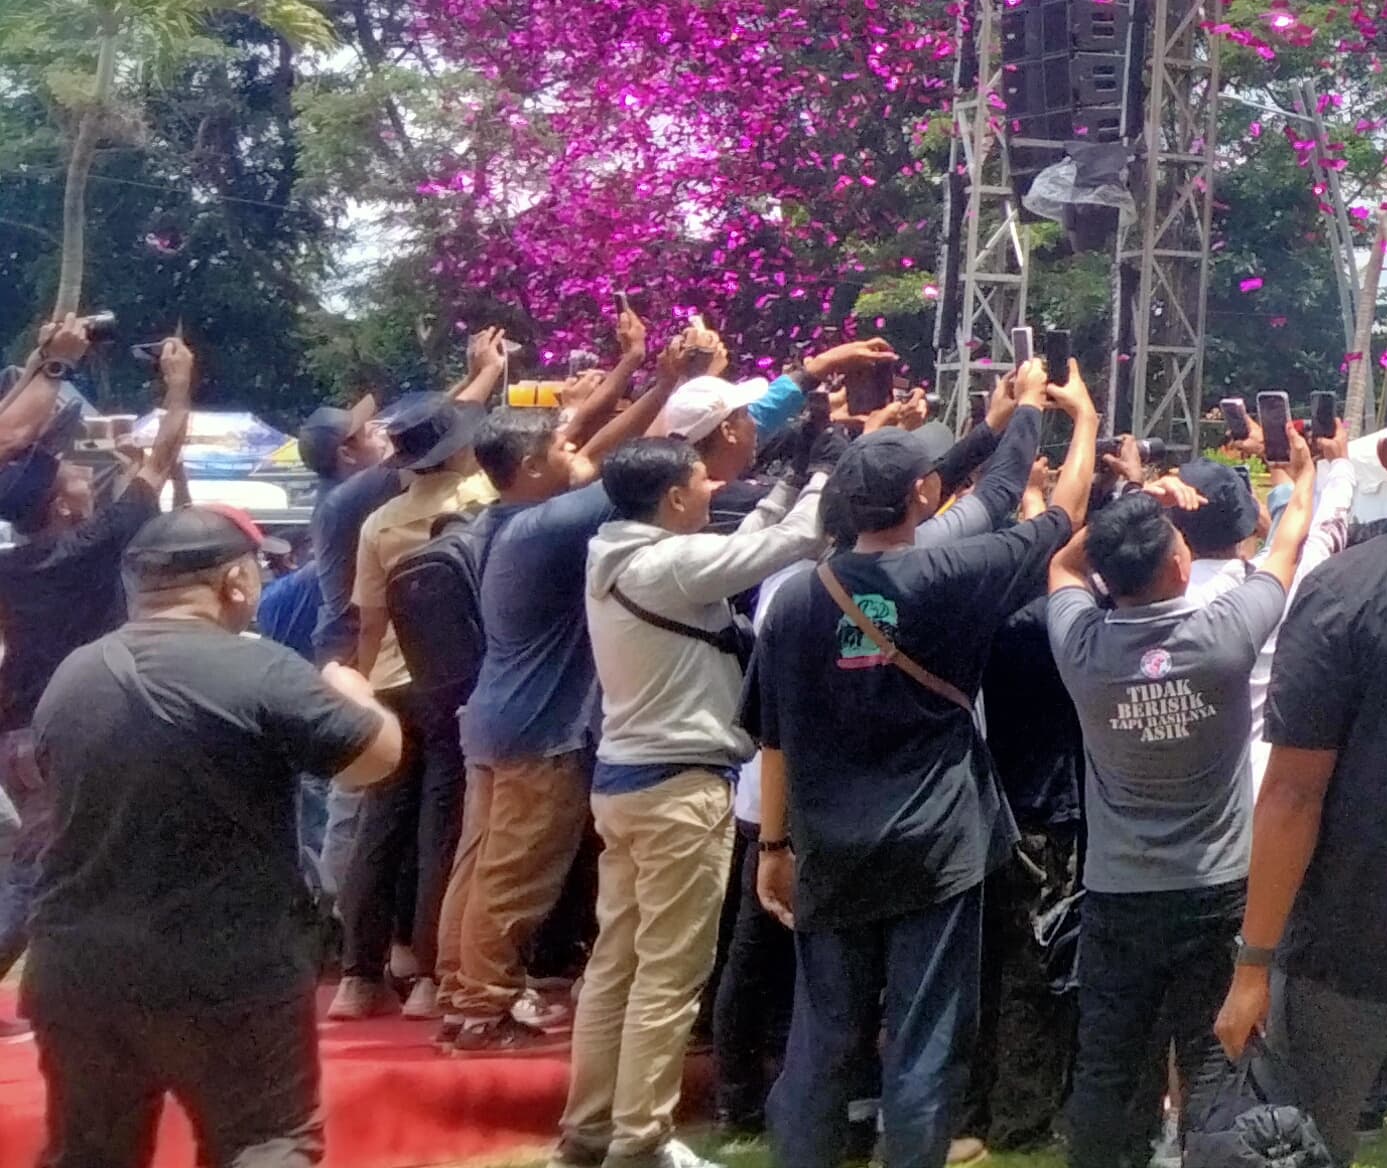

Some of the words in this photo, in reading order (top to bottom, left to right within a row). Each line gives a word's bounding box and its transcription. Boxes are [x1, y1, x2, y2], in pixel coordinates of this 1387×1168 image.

[1126, 679, 1192, 703] TIDAK
[1117, 692, 1205, 719] BERISIK
[1109, 718, 1143, 729] TAPI
[1140, 724, 1191, 742] ASIK
